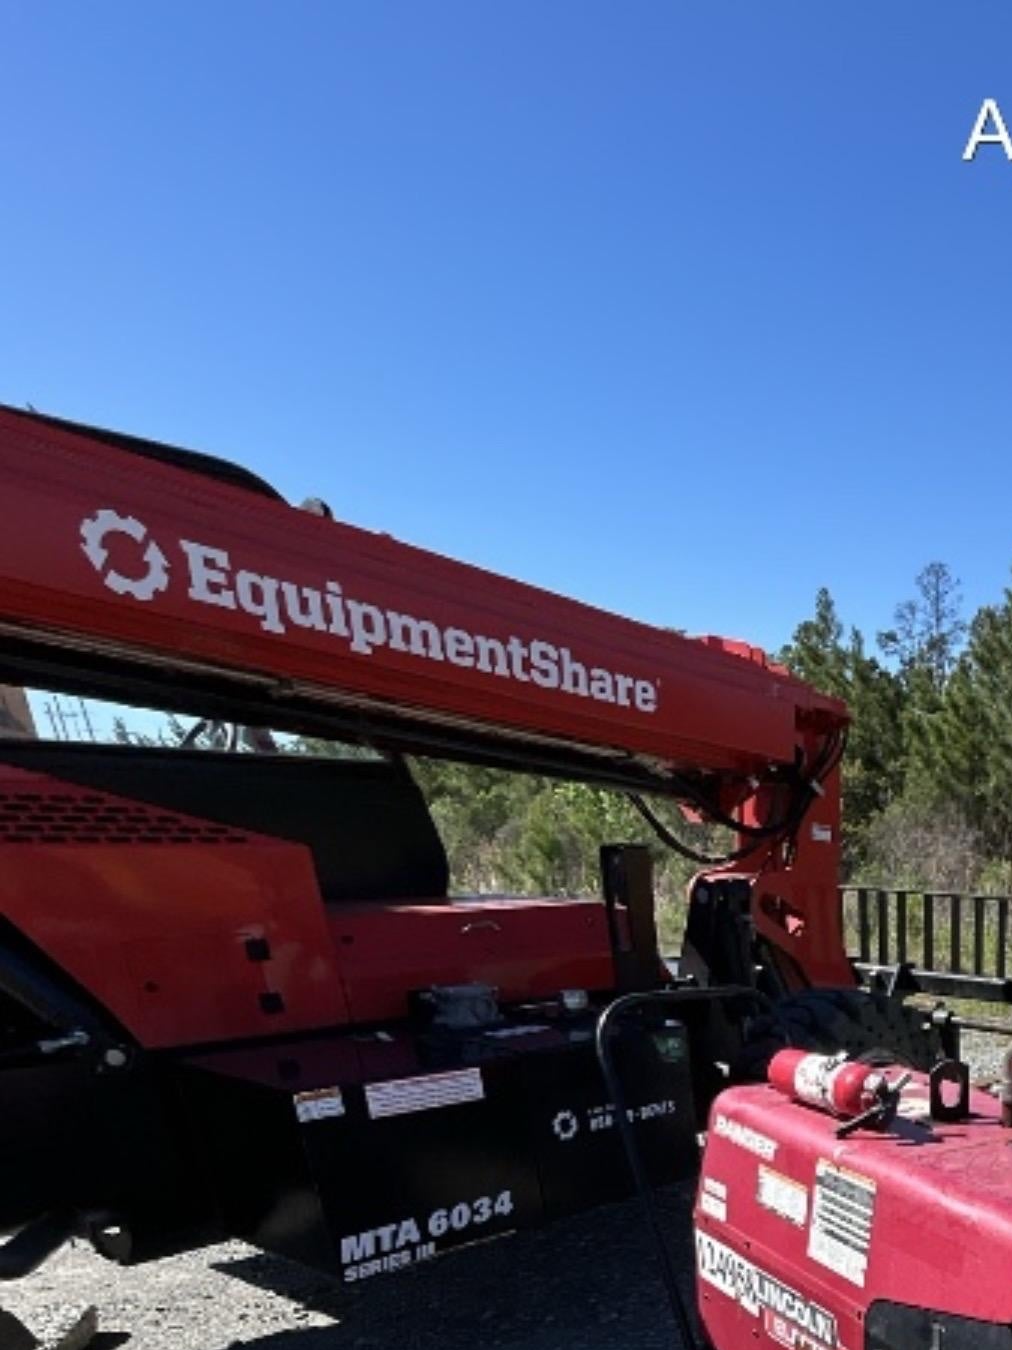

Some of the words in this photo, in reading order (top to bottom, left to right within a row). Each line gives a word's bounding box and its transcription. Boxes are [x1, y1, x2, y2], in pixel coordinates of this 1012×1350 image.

[179, 538, 659, 713] EquipmentShare
[340, 1217, 421, 1264] MTA
[427, 1190, 514, 1237] 6034
[343, 1250, 412, 1282] SERIES
